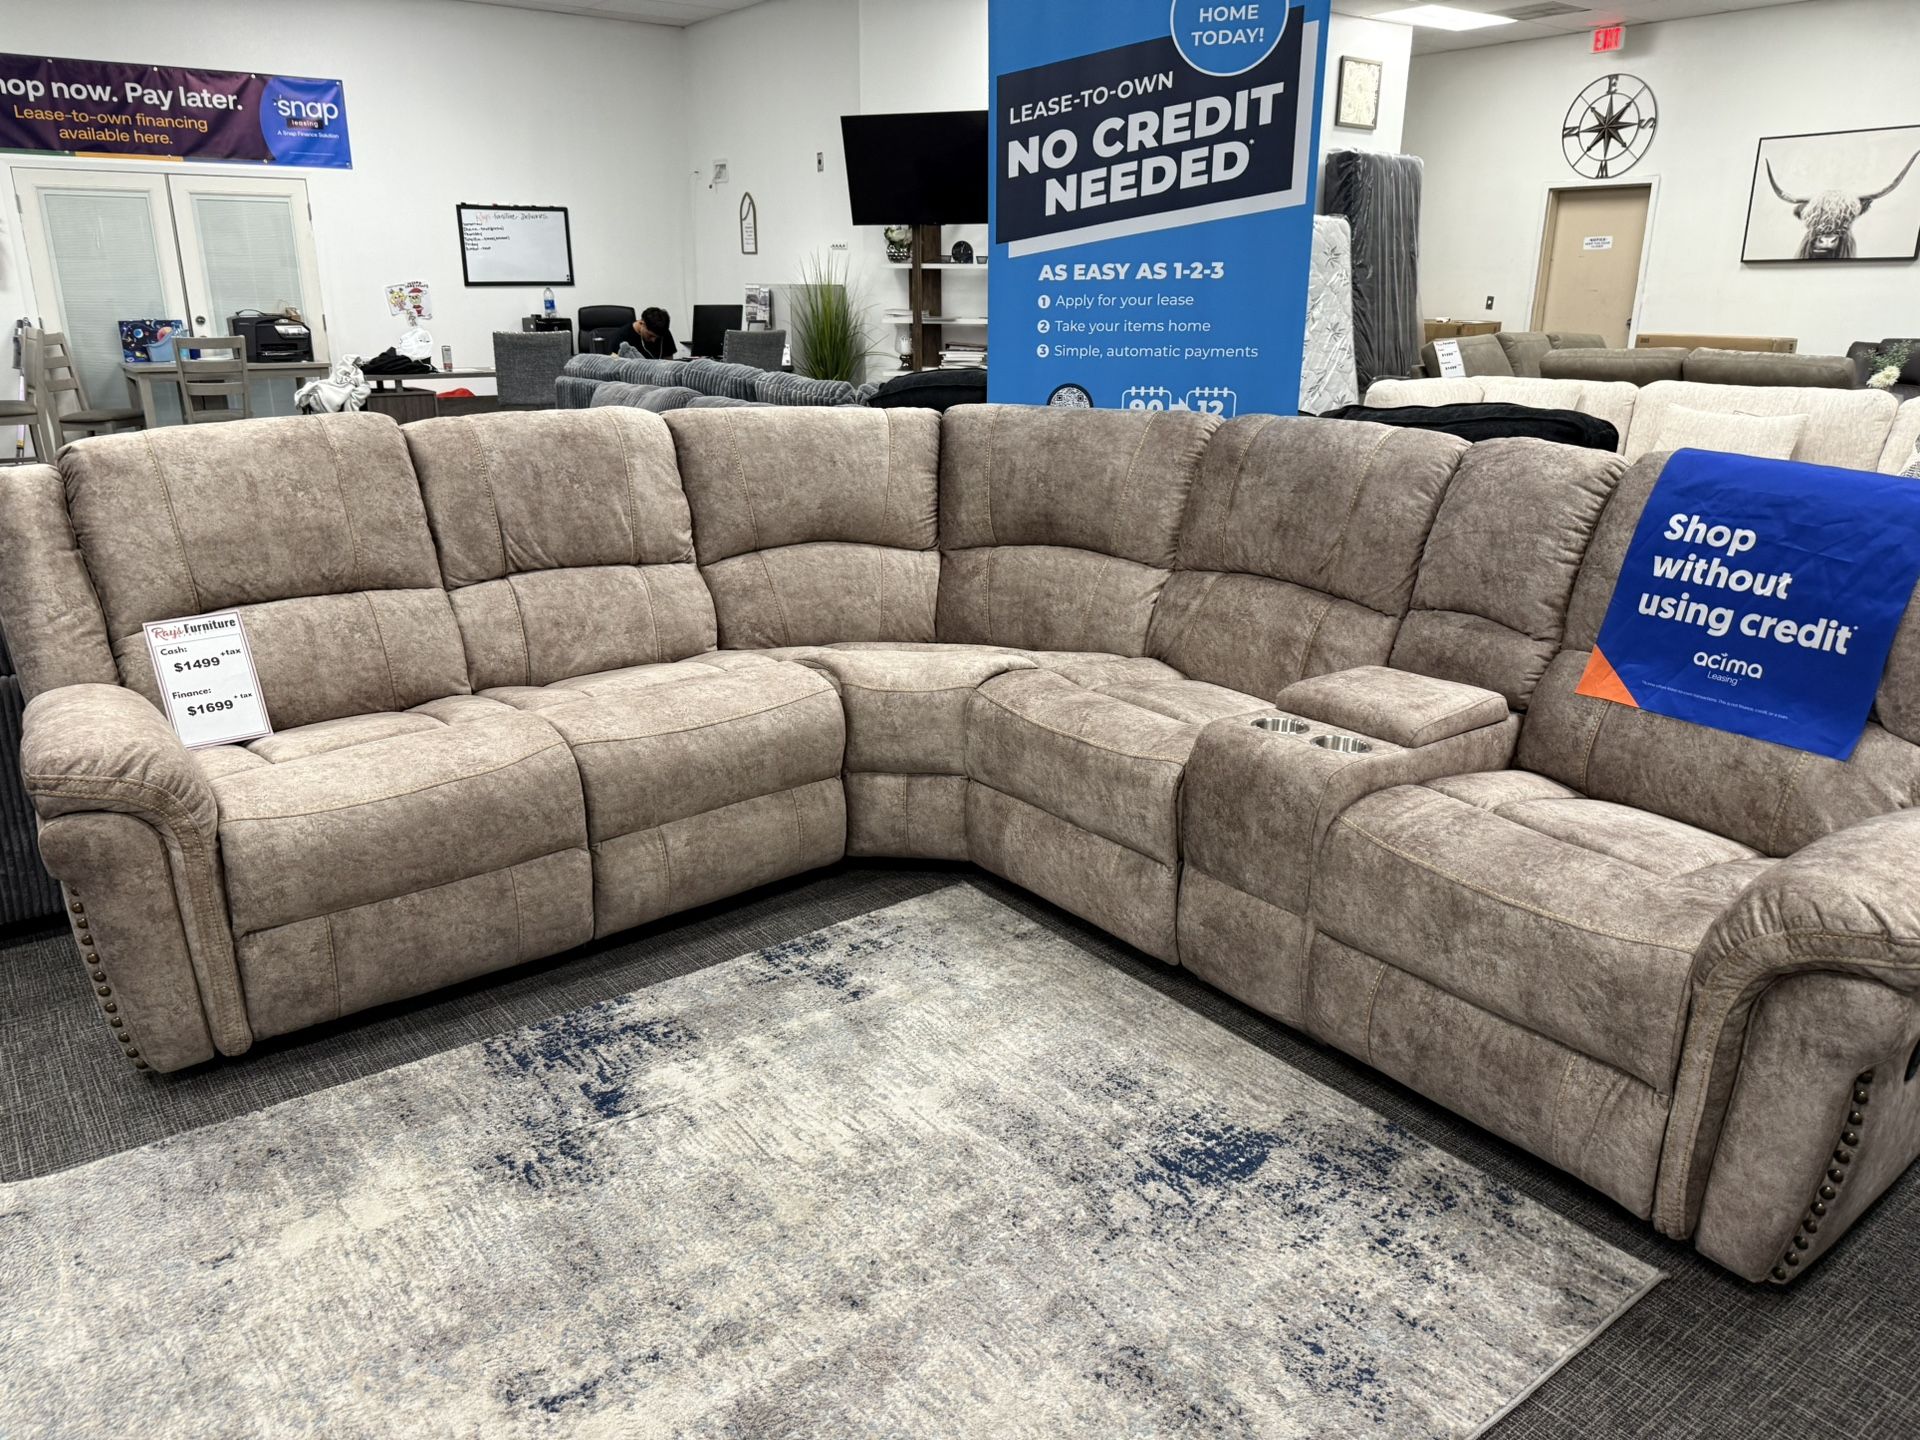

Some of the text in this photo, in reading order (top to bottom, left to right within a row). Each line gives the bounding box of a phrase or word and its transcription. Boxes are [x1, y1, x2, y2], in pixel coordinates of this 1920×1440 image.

[1199, 4, 1259, 22] HOME
[1191, 27, 1265, 46] TODAY!
[51, 81, 119, 103] now.
[124, 82, 173, 111] Pay
[179, 86, 243, 111] later.
[1009, 70, 1174, 125] LEASE-TO-OWN
[13, 104, 208, 133] Lease-to-own financing
[278, 99, 338, 126] snap
[291, 119, 319, 128] leasing
[1008, 81, 1285, 179] NO CREDIT
[59, 127, 173, 144] available here.
[1038, 261, 1224, 281] AS EASY AS 1-2-3
[1055, 294, 1095, 309] Apply
[1098, 294, 1117, 306] for
[1119, 297, 1153, 309] your
[1157, 294, 1194, 306] lease
[1055, 320, 1086, 332] Take
[1088, 323, 1120, 335] your
[1124, 319, 1165, 332] items
[1168, 319, 1211, 332] home
[1054, 345, 1103, 360] Simple,
[1106, 345, 1181, 357] automatic
[1184, 346, 1259, 360] payments
[1197, 400, 1224, 417] 12
[1663, 513, 1757, 557] Shop
[1652, 553, 1793, 600] without
[1637, 592, 1735, 637] using
[184, 619, 236, 634] Furniture
[160, 646, 188, 656] Cash:
[174, 656, 220, 673] $1499
[1693, 651, 1763, 679] acima
[1707, 670, 1738, 686] Leasing
[172, 688, 212, 699] Finance:
[187, 699, 234, 717] $1699
